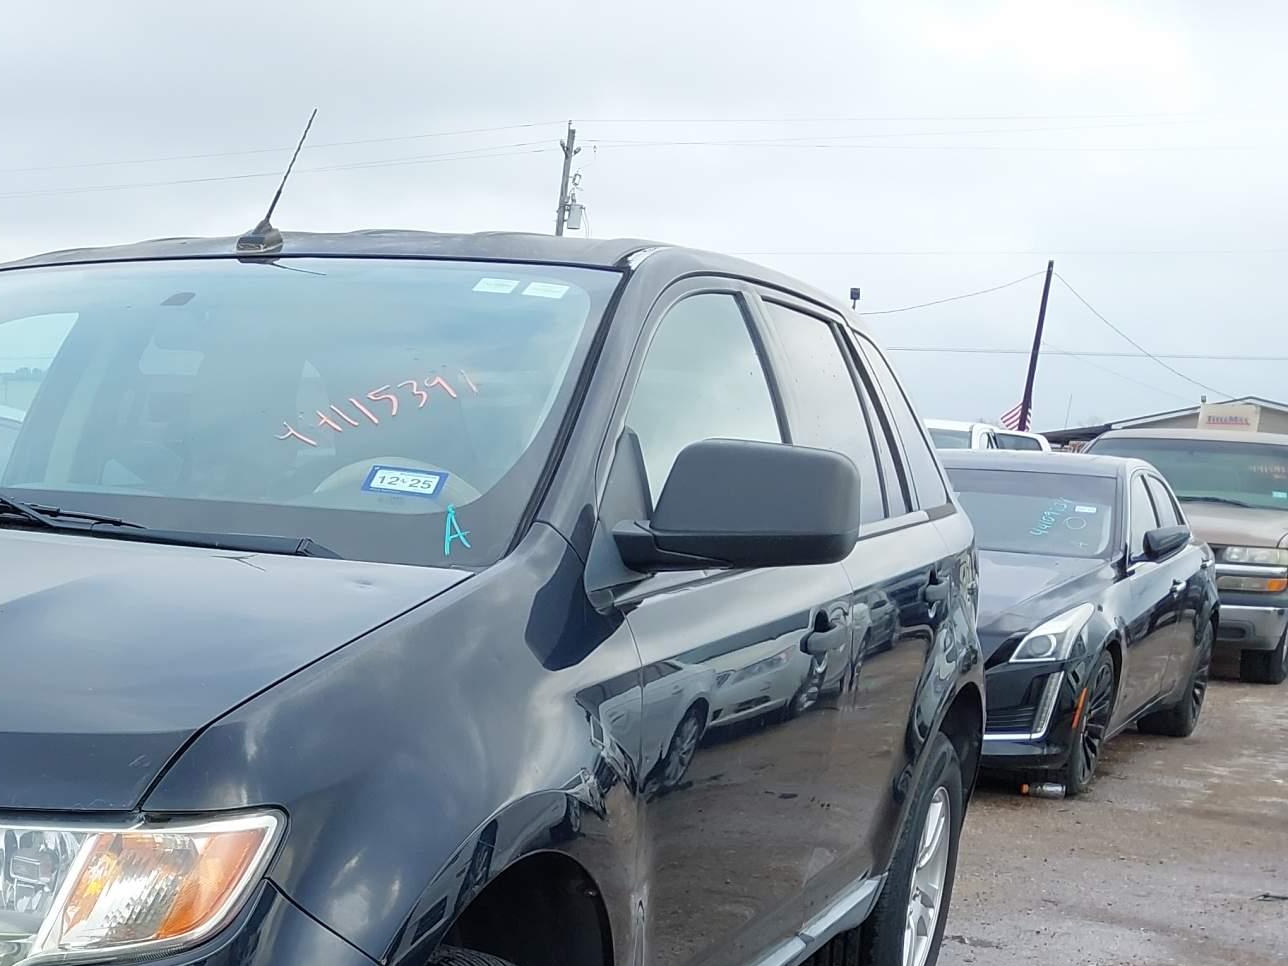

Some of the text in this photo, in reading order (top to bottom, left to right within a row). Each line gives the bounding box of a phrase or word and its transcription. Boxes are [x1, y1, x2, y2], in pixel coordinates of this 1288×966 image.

[378, 474, 400, 487] 12
[408, 478, 434, 490] 25
[444, 503, 470, 556] A
